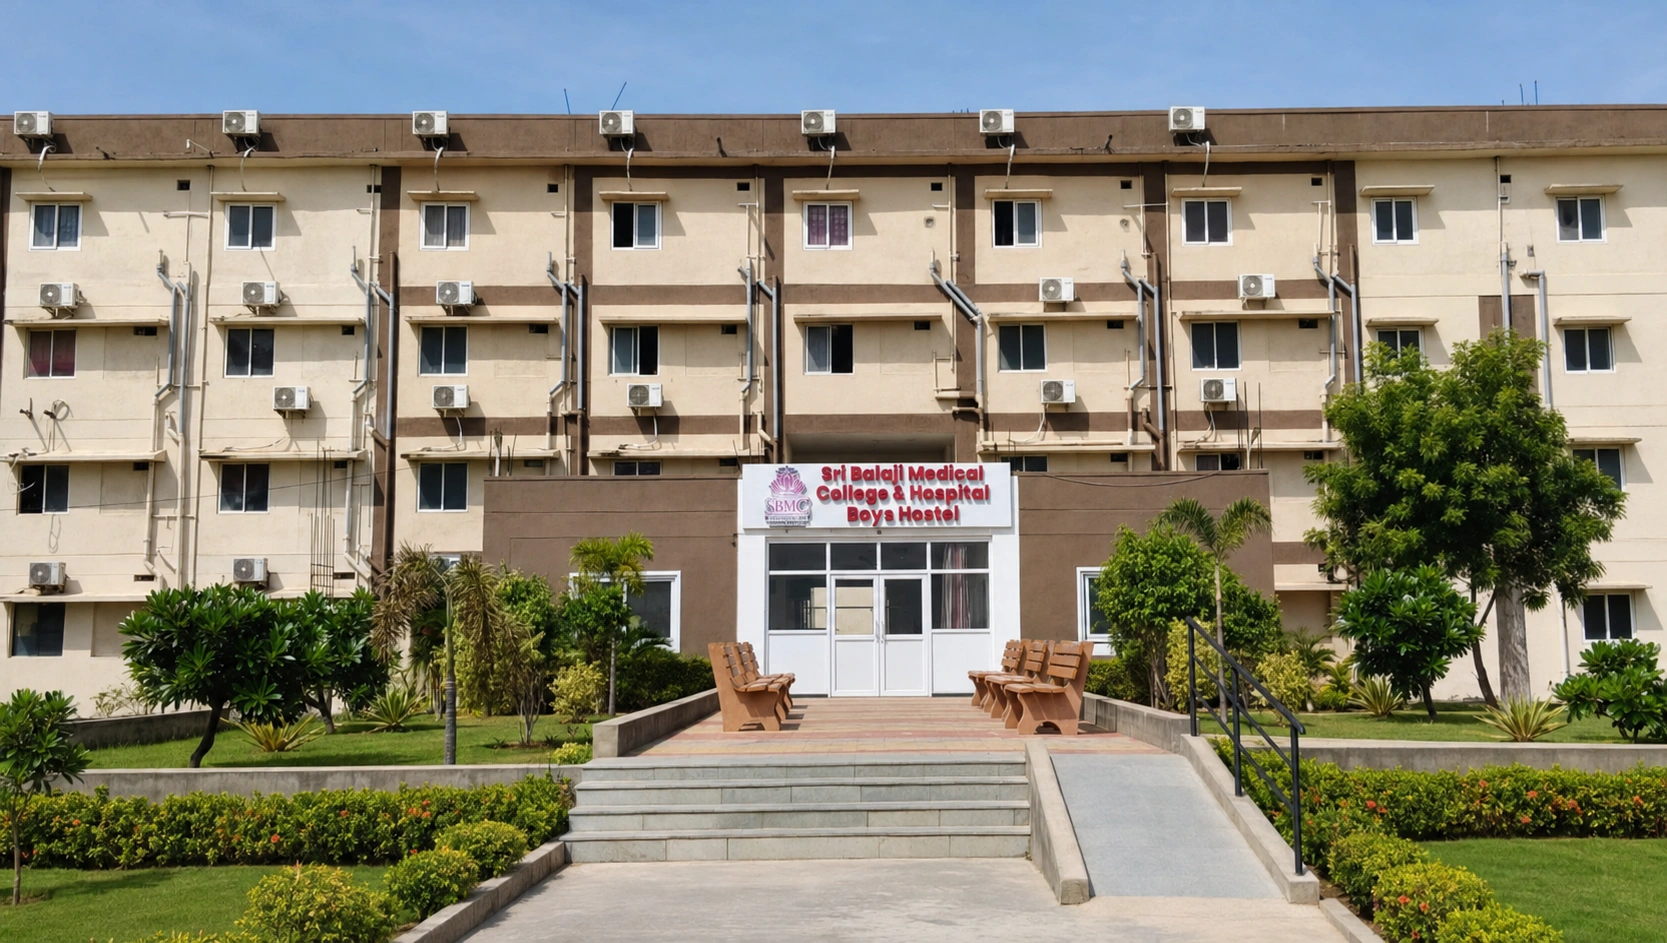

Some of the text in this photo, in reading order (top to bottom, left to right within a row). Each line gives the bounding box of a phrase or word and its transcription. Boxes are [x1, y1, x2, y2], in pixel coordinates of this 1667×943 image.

[821, 464, 984, 485] Sri Balaji Medical
[816, 484, 990, 505] College & Hospital
[765, 498, 810, 514] SBMC
[847, 505, 959, 527] Boys Hostel
